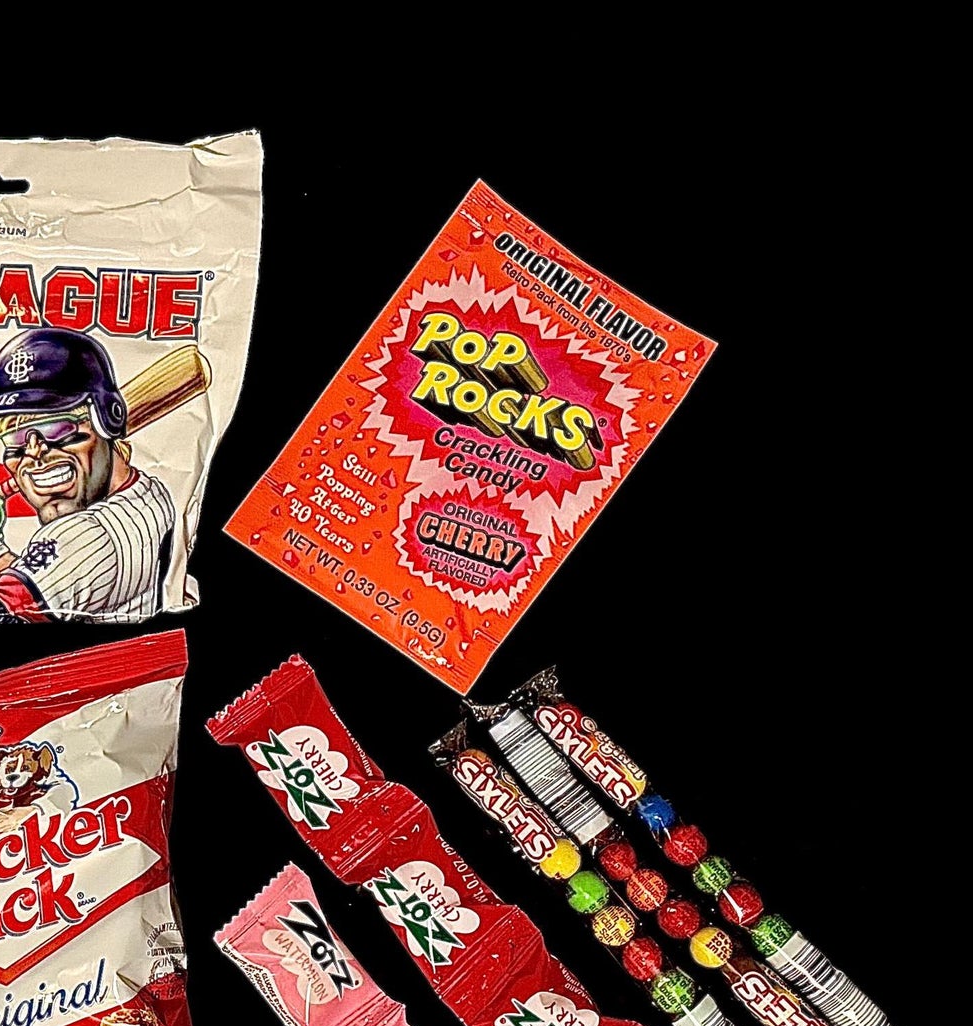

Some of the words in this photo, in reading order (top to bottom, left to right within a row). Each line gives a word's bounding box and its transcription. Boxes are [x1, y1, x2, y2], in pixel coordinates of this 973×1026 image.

[494, 232, 591, 311] ORIGINAL
[585, 295, 667, 362] FLAVOR
[501, 261, 529, 288] Retro
[530, 283, 557, 307] Pack
[555, 303, 580, 325] from
[411, 312, 547, 390] POP
[411, 360, 604, 468] ROCKS
[343, 454, 377, 487] Still
[434, 426, 548, 481] Crackling
[445, 452, 523, 494] Candy
[309, 487, 357, 525] After
[316, 463, 376, 517] Popping
[289, 498, 312, 523] 40
[315, 514, 354, 553] Years
[419, 513, 524, 569] CHERRY
[443, 502, 517, 537] ORIGINAL
[283, 528, 319, 557] NET
[317, 550, 343, 576] WT.
[343, 569, 375, 597] 0.33
[375, 592, 401, 616] OZ.
[401, 609, 446, 648] (9.5G)
[422, 546, 498, 578] ARTIFICIALLY
[428, 559, 487, 587] FLAVORED
[295, 736, 343, 792] CHERRY
[534, 706, 639, 809] SIXLETS
[453, 756, 558, 863] SIXLETS
[411, 871, 461, 923] CHERRY
[274, 932, 329, 1002] WATERMELON
